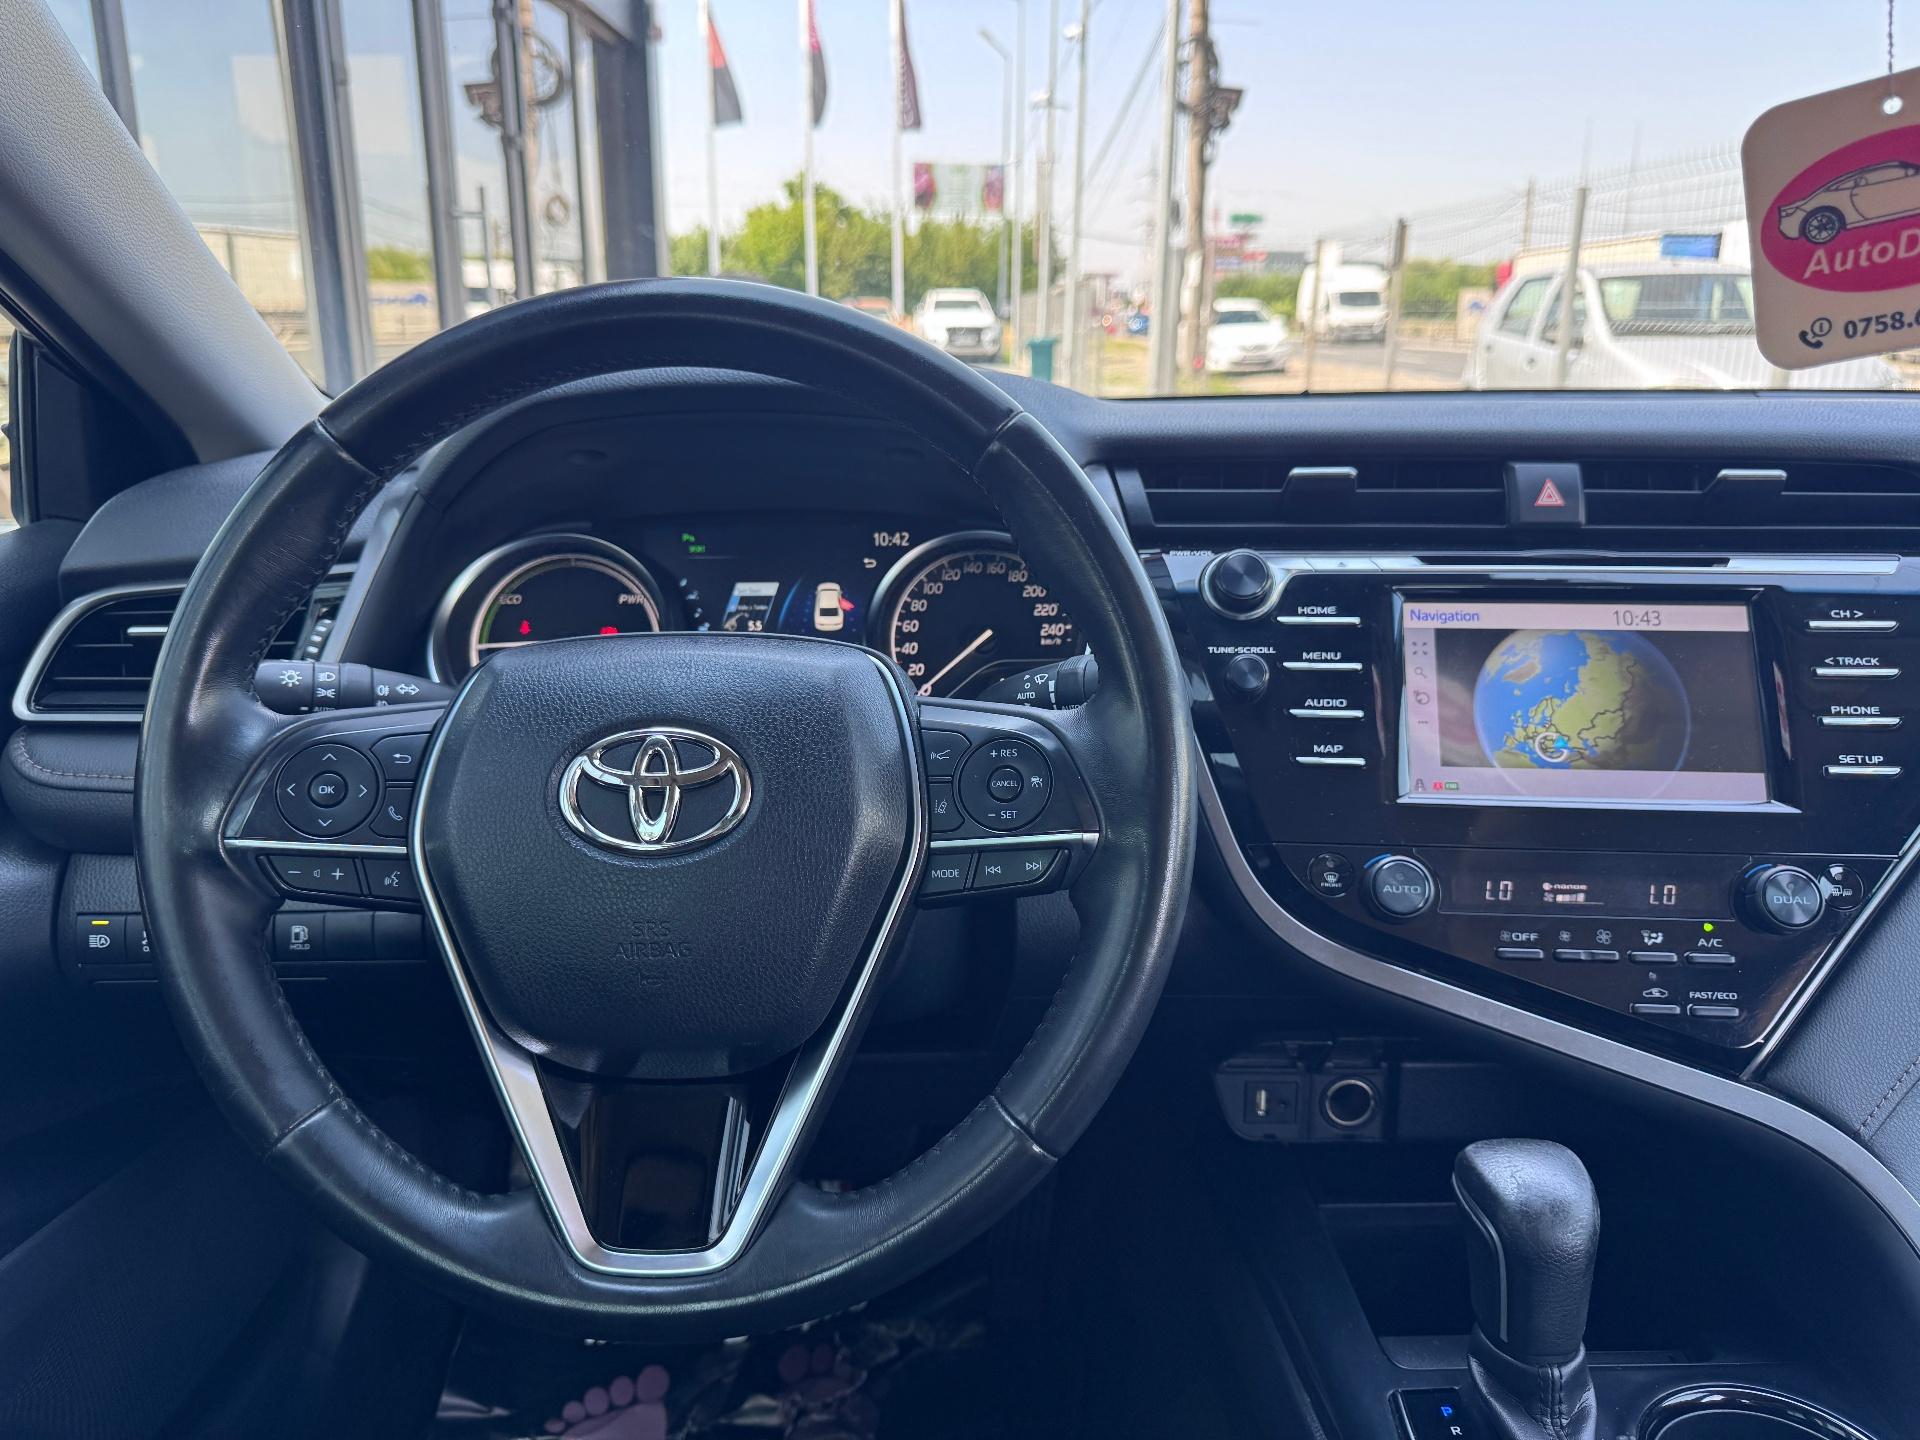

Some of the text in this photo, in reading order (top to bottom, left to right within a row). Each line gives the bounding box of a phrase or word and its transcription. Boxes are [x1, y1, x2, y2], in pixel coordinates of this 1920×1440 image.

[873, 532, 910, 547] 10:42
[963, 562, 982, 574] 140
[986, 562, 1006, 574] 160
[941, 569, 960, 581] 120
[1008, 570, 1028, 582] 180
[923, 582, 943, 595] 100
[910, 600, 928, 612] 80
[1033, 604, 1058, 616] 220
[1297, 605, 1337, 615] HOME
[1409, 609, 1480, 624] Navigation
[1612, 610, 1662, 627] 10:43
[902, 620, 920, 633] 60
[1040, 623, 1065, 636] 240
[901, 642, 919, 655] 40
[1302, 651, 1342, 661] MENU
[908, 663, 925, 676] 20
[1016, 692, 1036, 700] AUTO
[1304, 698, 1348, 708] AUDIO
[1831, 705, 1880, 715] PHONE
[1313, 744, 1344, 754] MAP
[991, 779, 1018, 788] CANCEL
[318, 785, 335, 795] OK
[931, 867, 960, 878] MODE
[1382, 885, 1422, 894] AUTO
[1773, 895, 1811, 905] DUAL
[631, 920, 671, 937] SRS
[1511, 932, 1540, 941] OFF
[1697, 938, 1723, 948] A/C
[1689, 991, 1738, 1000] FAST/ECO
[1440, 1406, 1453, 1417] P
[1450, 1426, 1463, 1436] R
